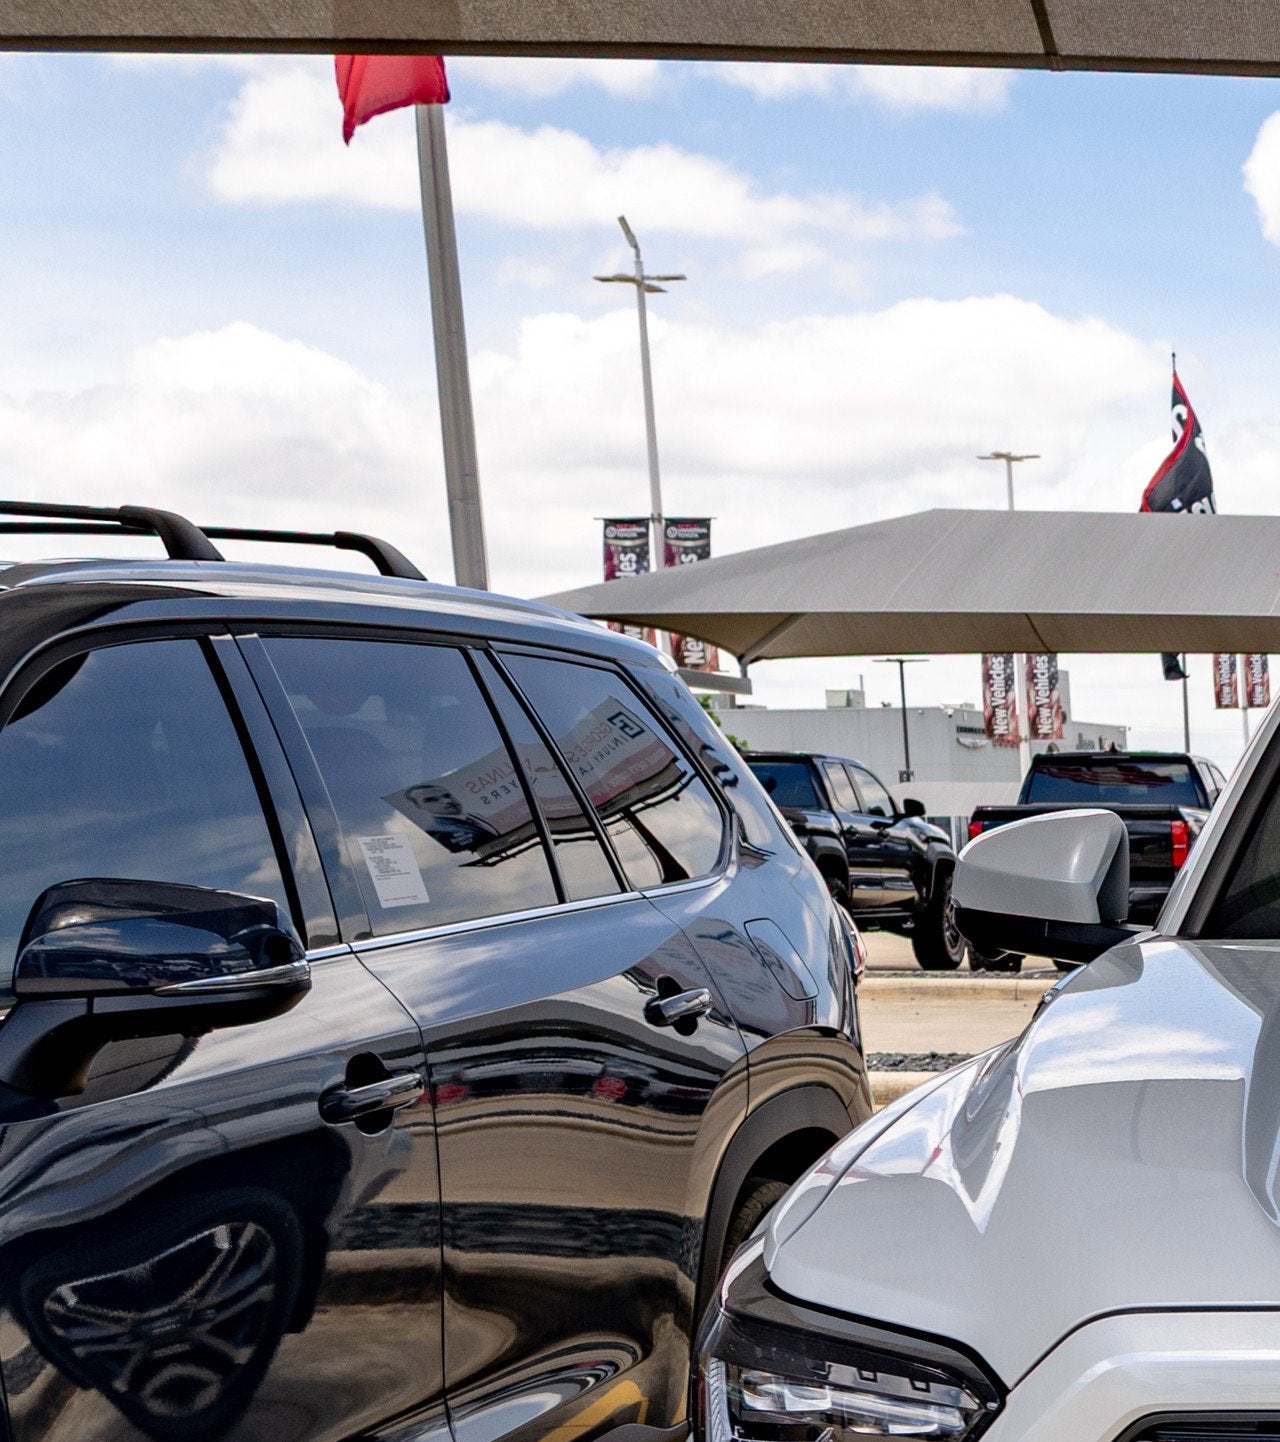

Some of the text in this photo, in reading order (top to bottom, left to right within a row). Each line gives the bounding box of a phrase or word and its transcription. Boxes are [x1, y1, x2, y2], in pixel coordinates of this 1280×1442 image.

[989, 656, 1008, 734] New Vehicles
[1034, 655, 1052, 734] New Vehicles
